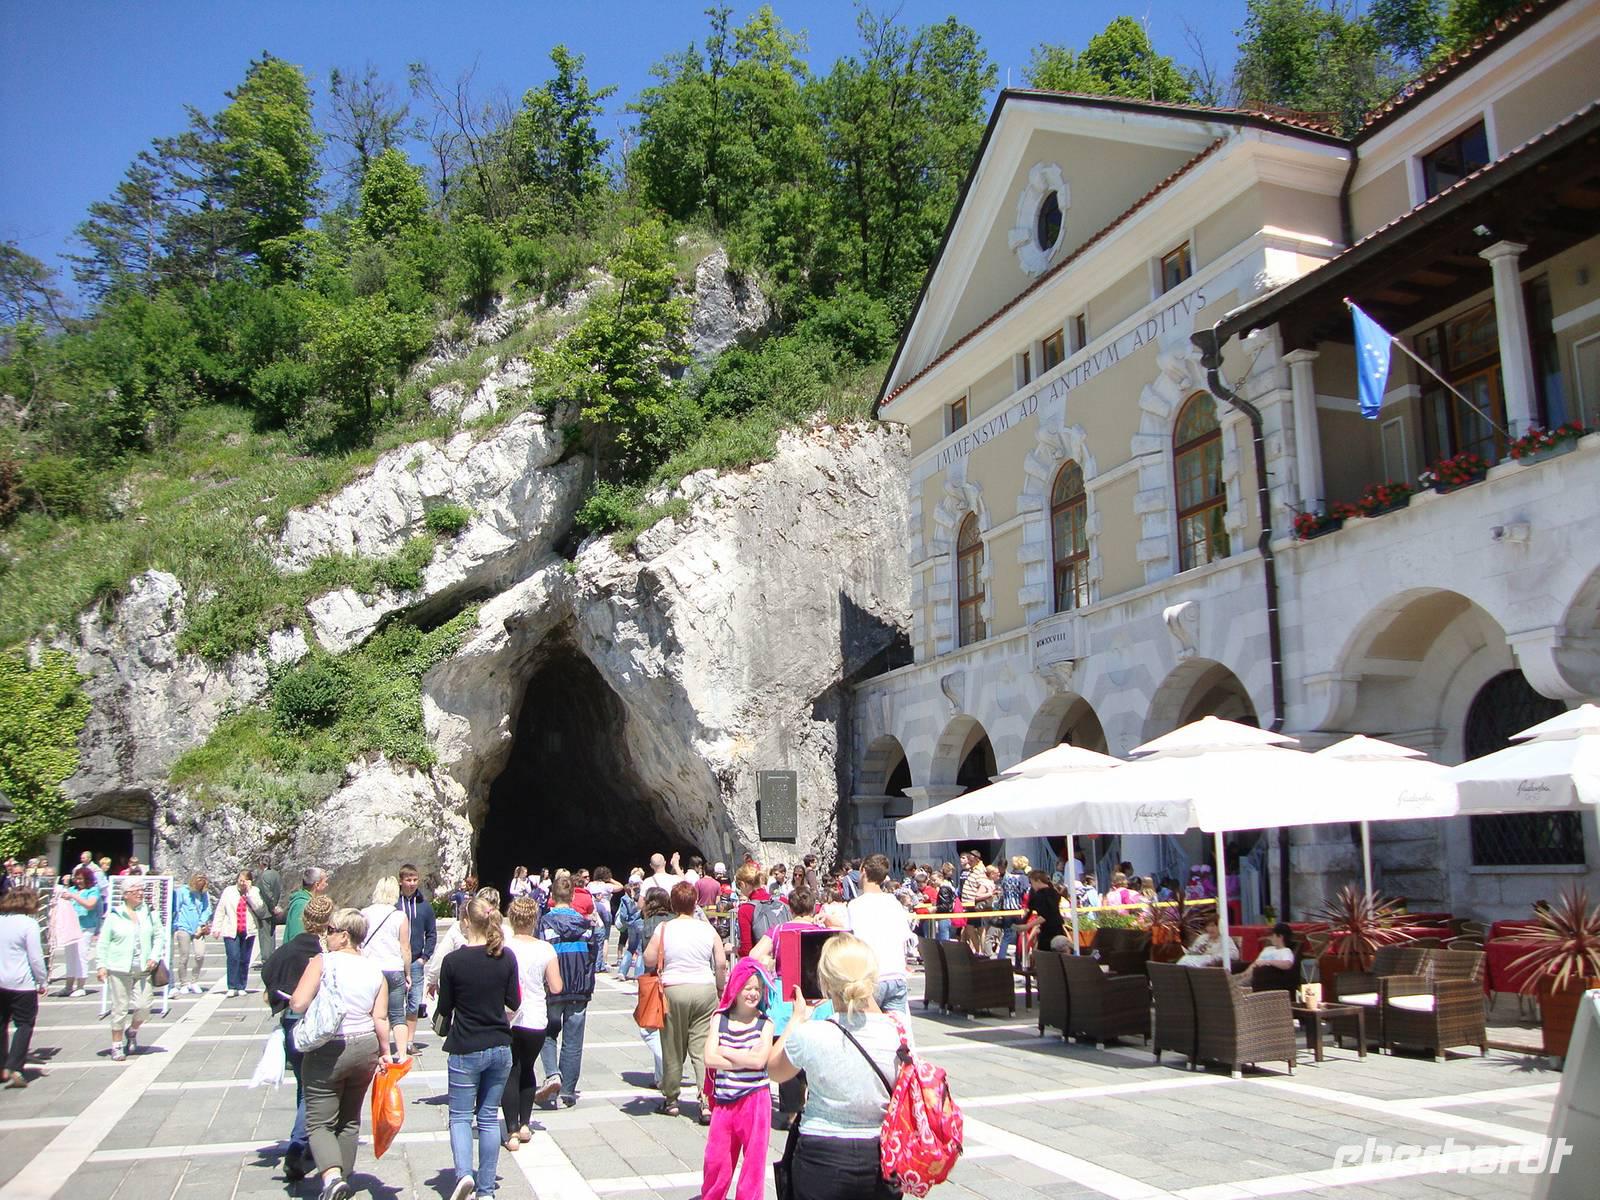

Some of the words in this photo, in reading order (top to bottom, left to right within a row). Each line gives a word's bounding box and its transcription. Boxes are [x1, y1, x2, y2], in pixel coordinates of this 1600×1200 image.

[936, 411, 1010, 473] IMMENSVM
[1019, 394, 1040, 419] AD
[1049, 342, 1121, 402] ANTRVM
[1133, 287, 1207, 351] ADITVS
